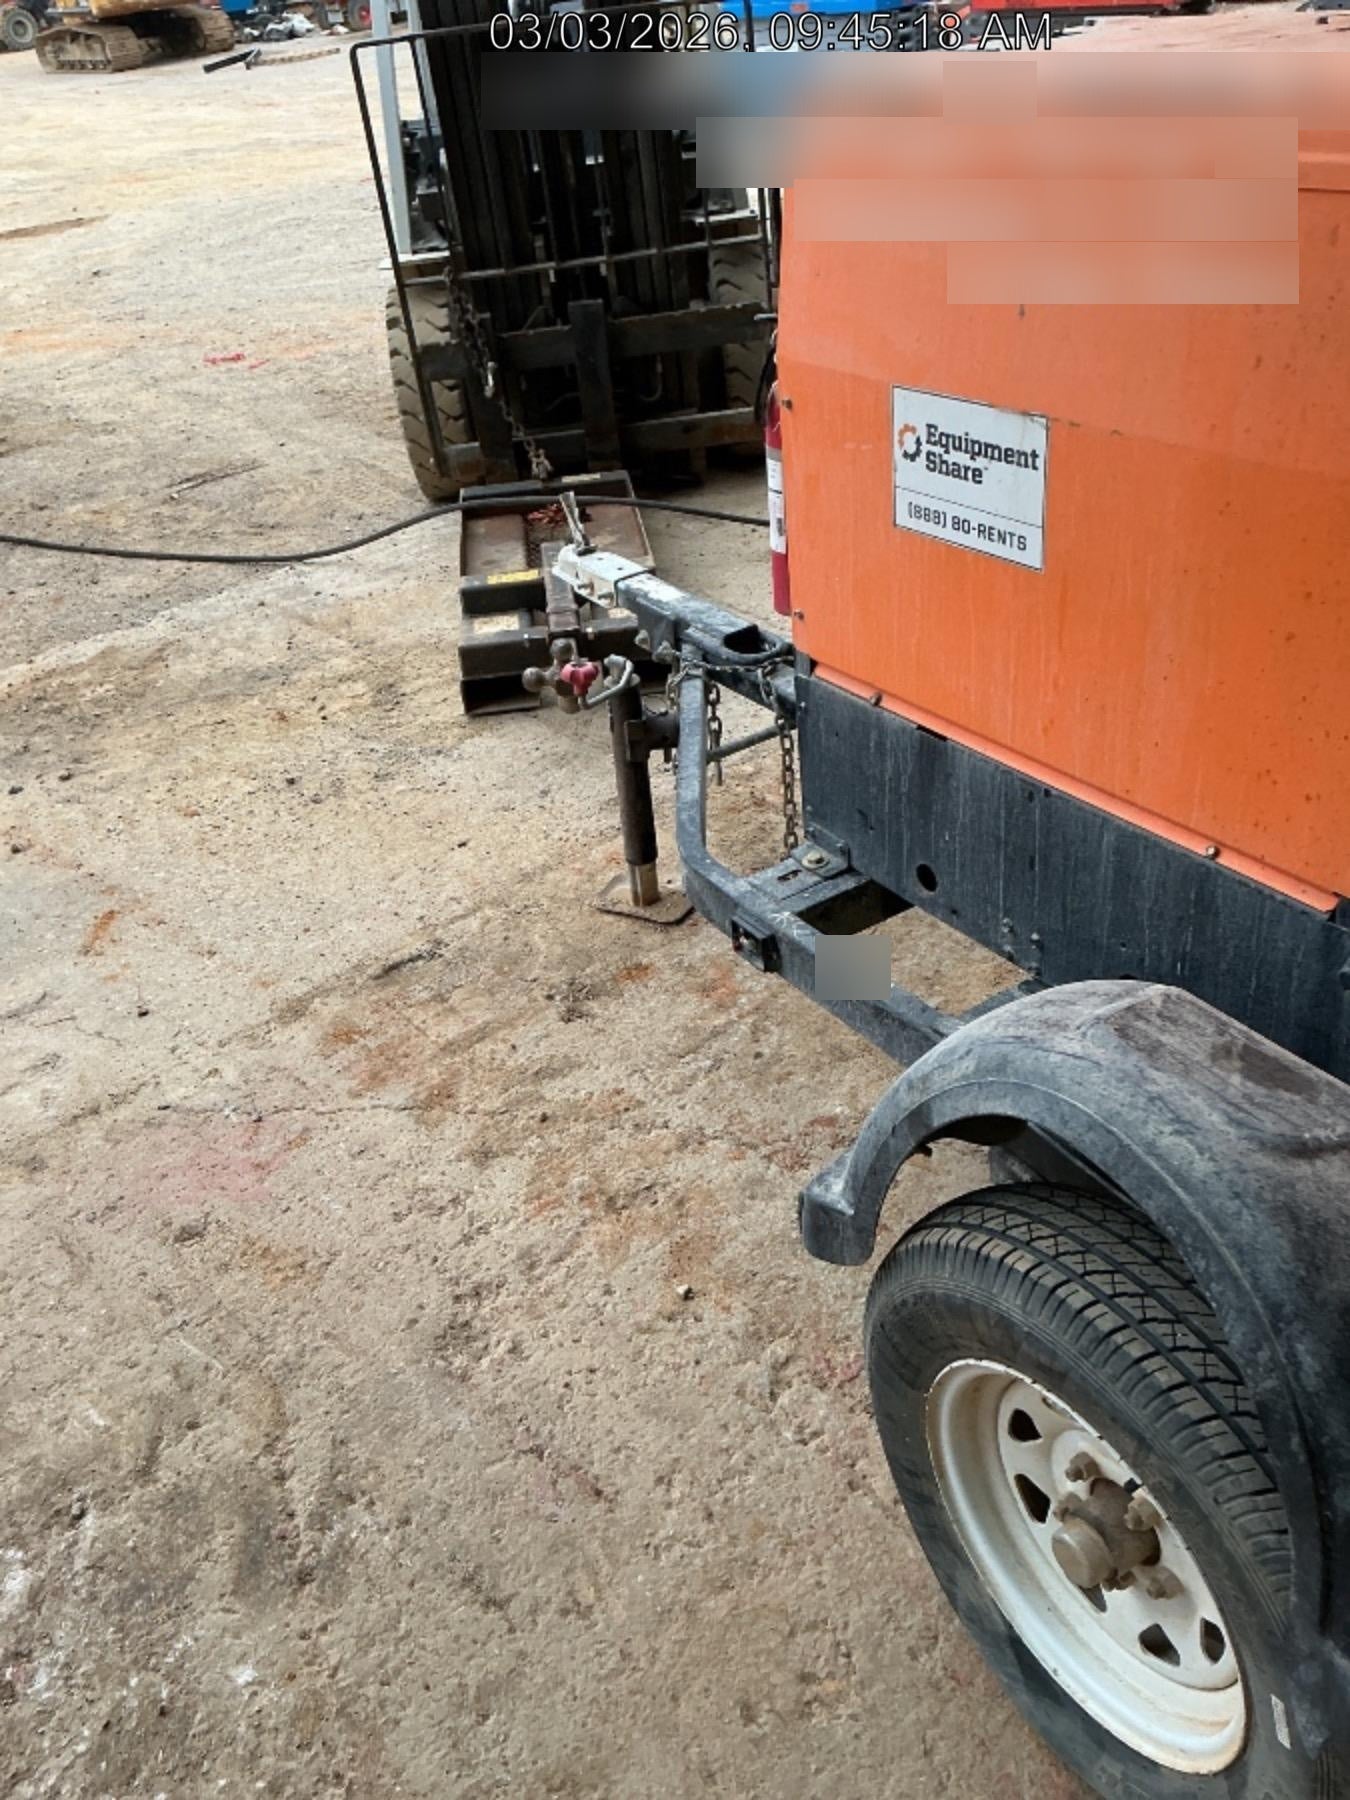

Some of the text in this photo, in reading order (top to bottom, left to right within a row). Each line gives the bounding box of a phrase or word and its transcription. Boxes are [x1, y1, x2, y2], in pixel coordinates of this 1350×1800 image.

[925, 423, 1040, 471] Equipment
[908, 501, 1027, 551] (888) 80-RENTS
